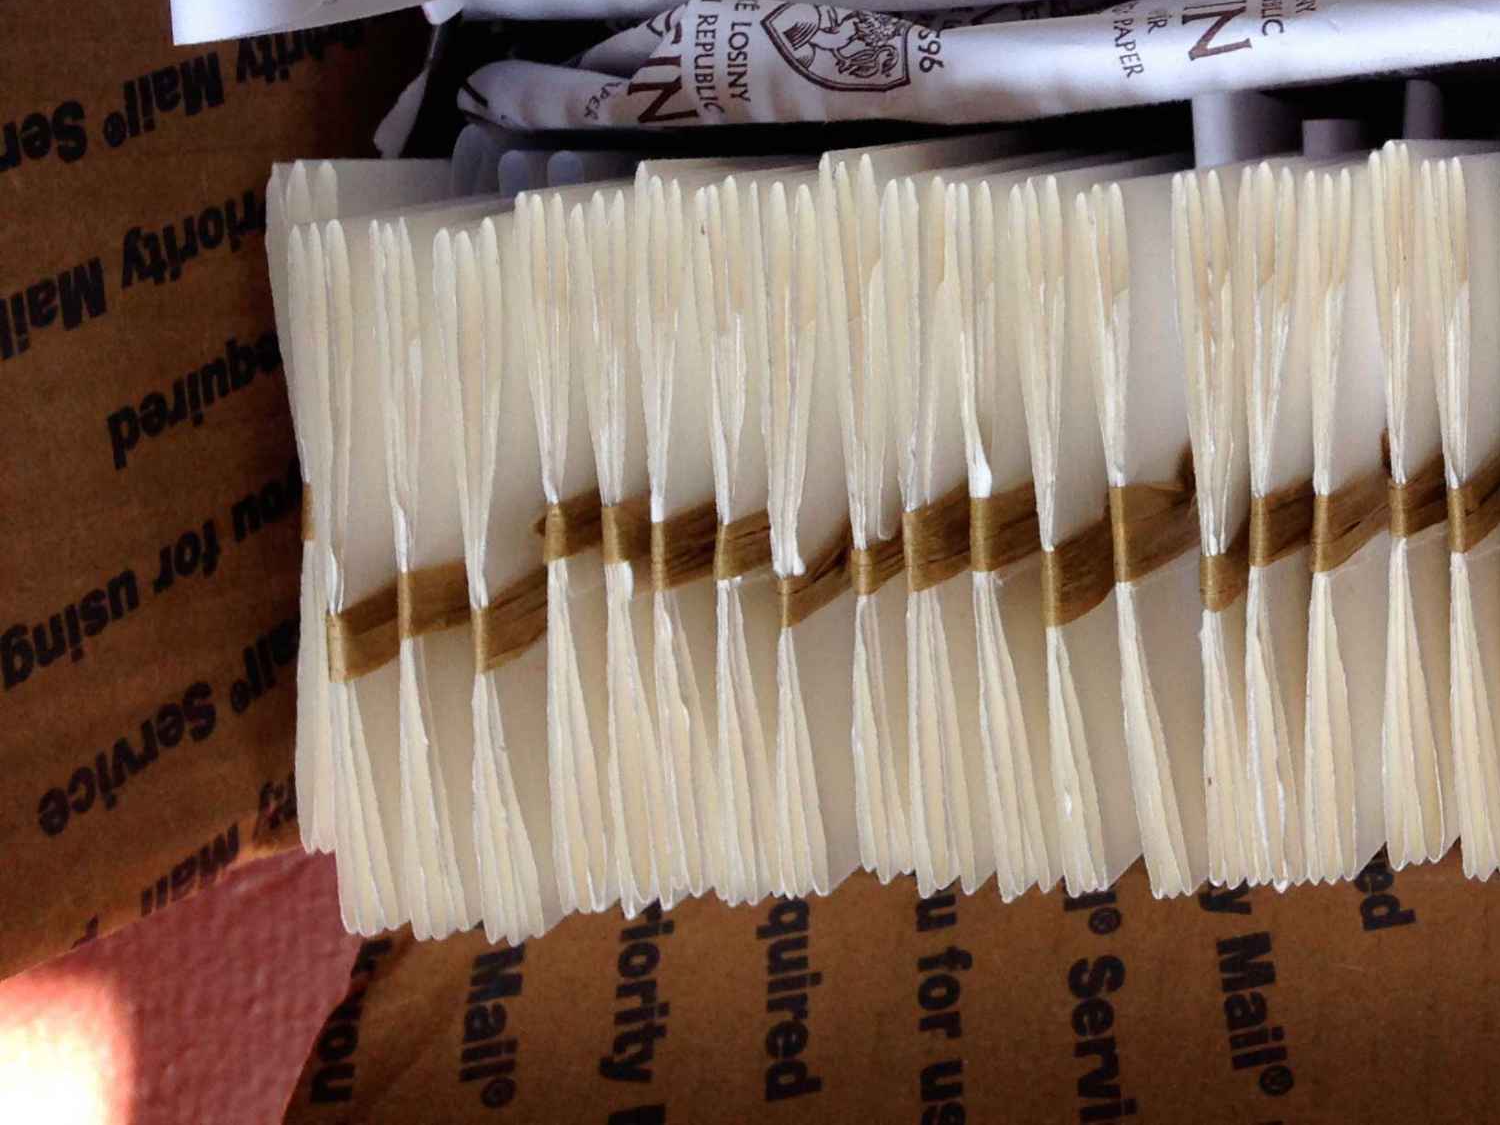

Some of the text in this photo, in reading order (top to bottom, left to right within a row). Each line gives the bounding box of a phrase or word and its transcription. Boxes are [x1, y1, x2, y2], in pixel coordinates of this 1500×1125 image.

[693, 13, 728, 115] REPUBLIC
[727, 18, 755, 104] LOSINY
[1112, 17, 1145, 79] PAPER
[153, 519, 221, 593] for
[0, 569, 140, 677] using
[38, 680, 217, 837] Service
[459, 939, 527, 1109] Mail®
[756, 893, 823, 1103] quired
[917, 946, 973, 1039] for
[1068, 954, 1138, 1125] Servi
[1216, 931, 1295, 1097] Mail®
